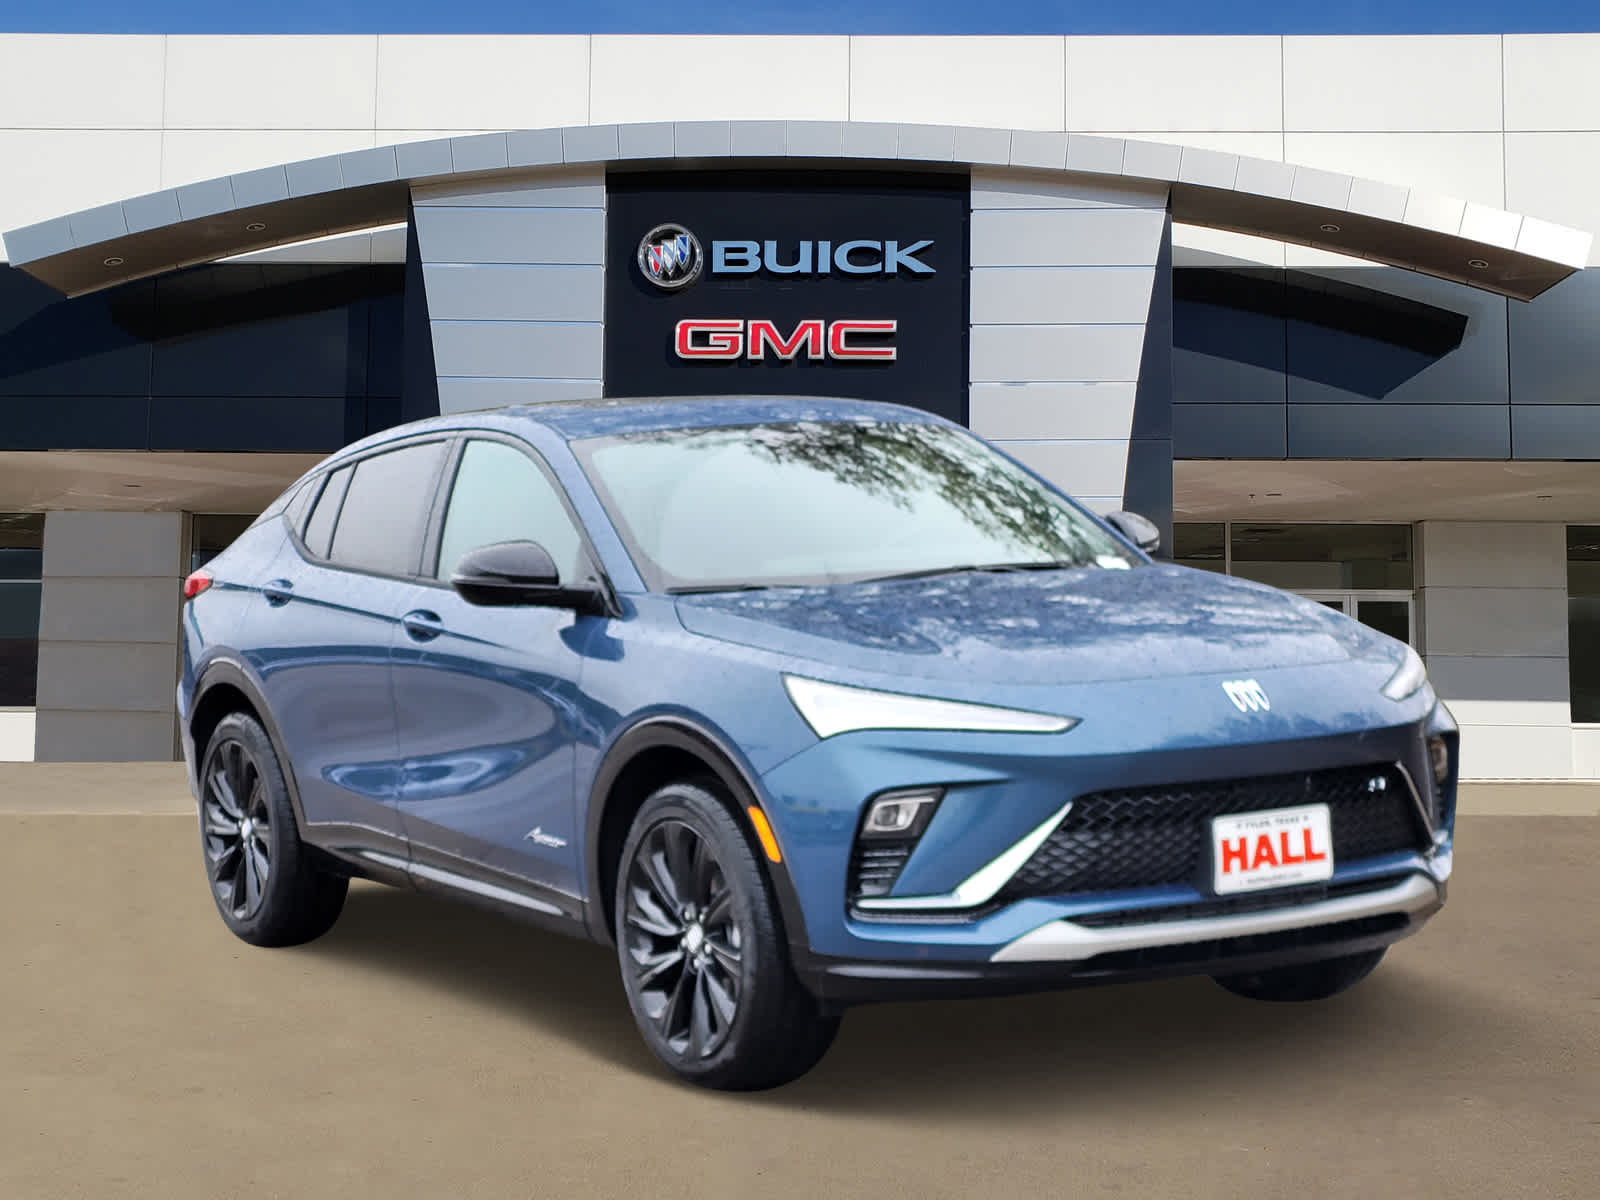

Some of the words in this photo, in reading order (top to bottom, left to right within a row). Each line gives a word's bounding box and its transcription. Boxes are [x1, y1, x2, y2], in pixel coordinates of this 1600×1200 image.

[712, 240, 936, 273] BUICK
[675, 319, 897, 360] GMC
[1221, 828, 1326, 874] HALL
